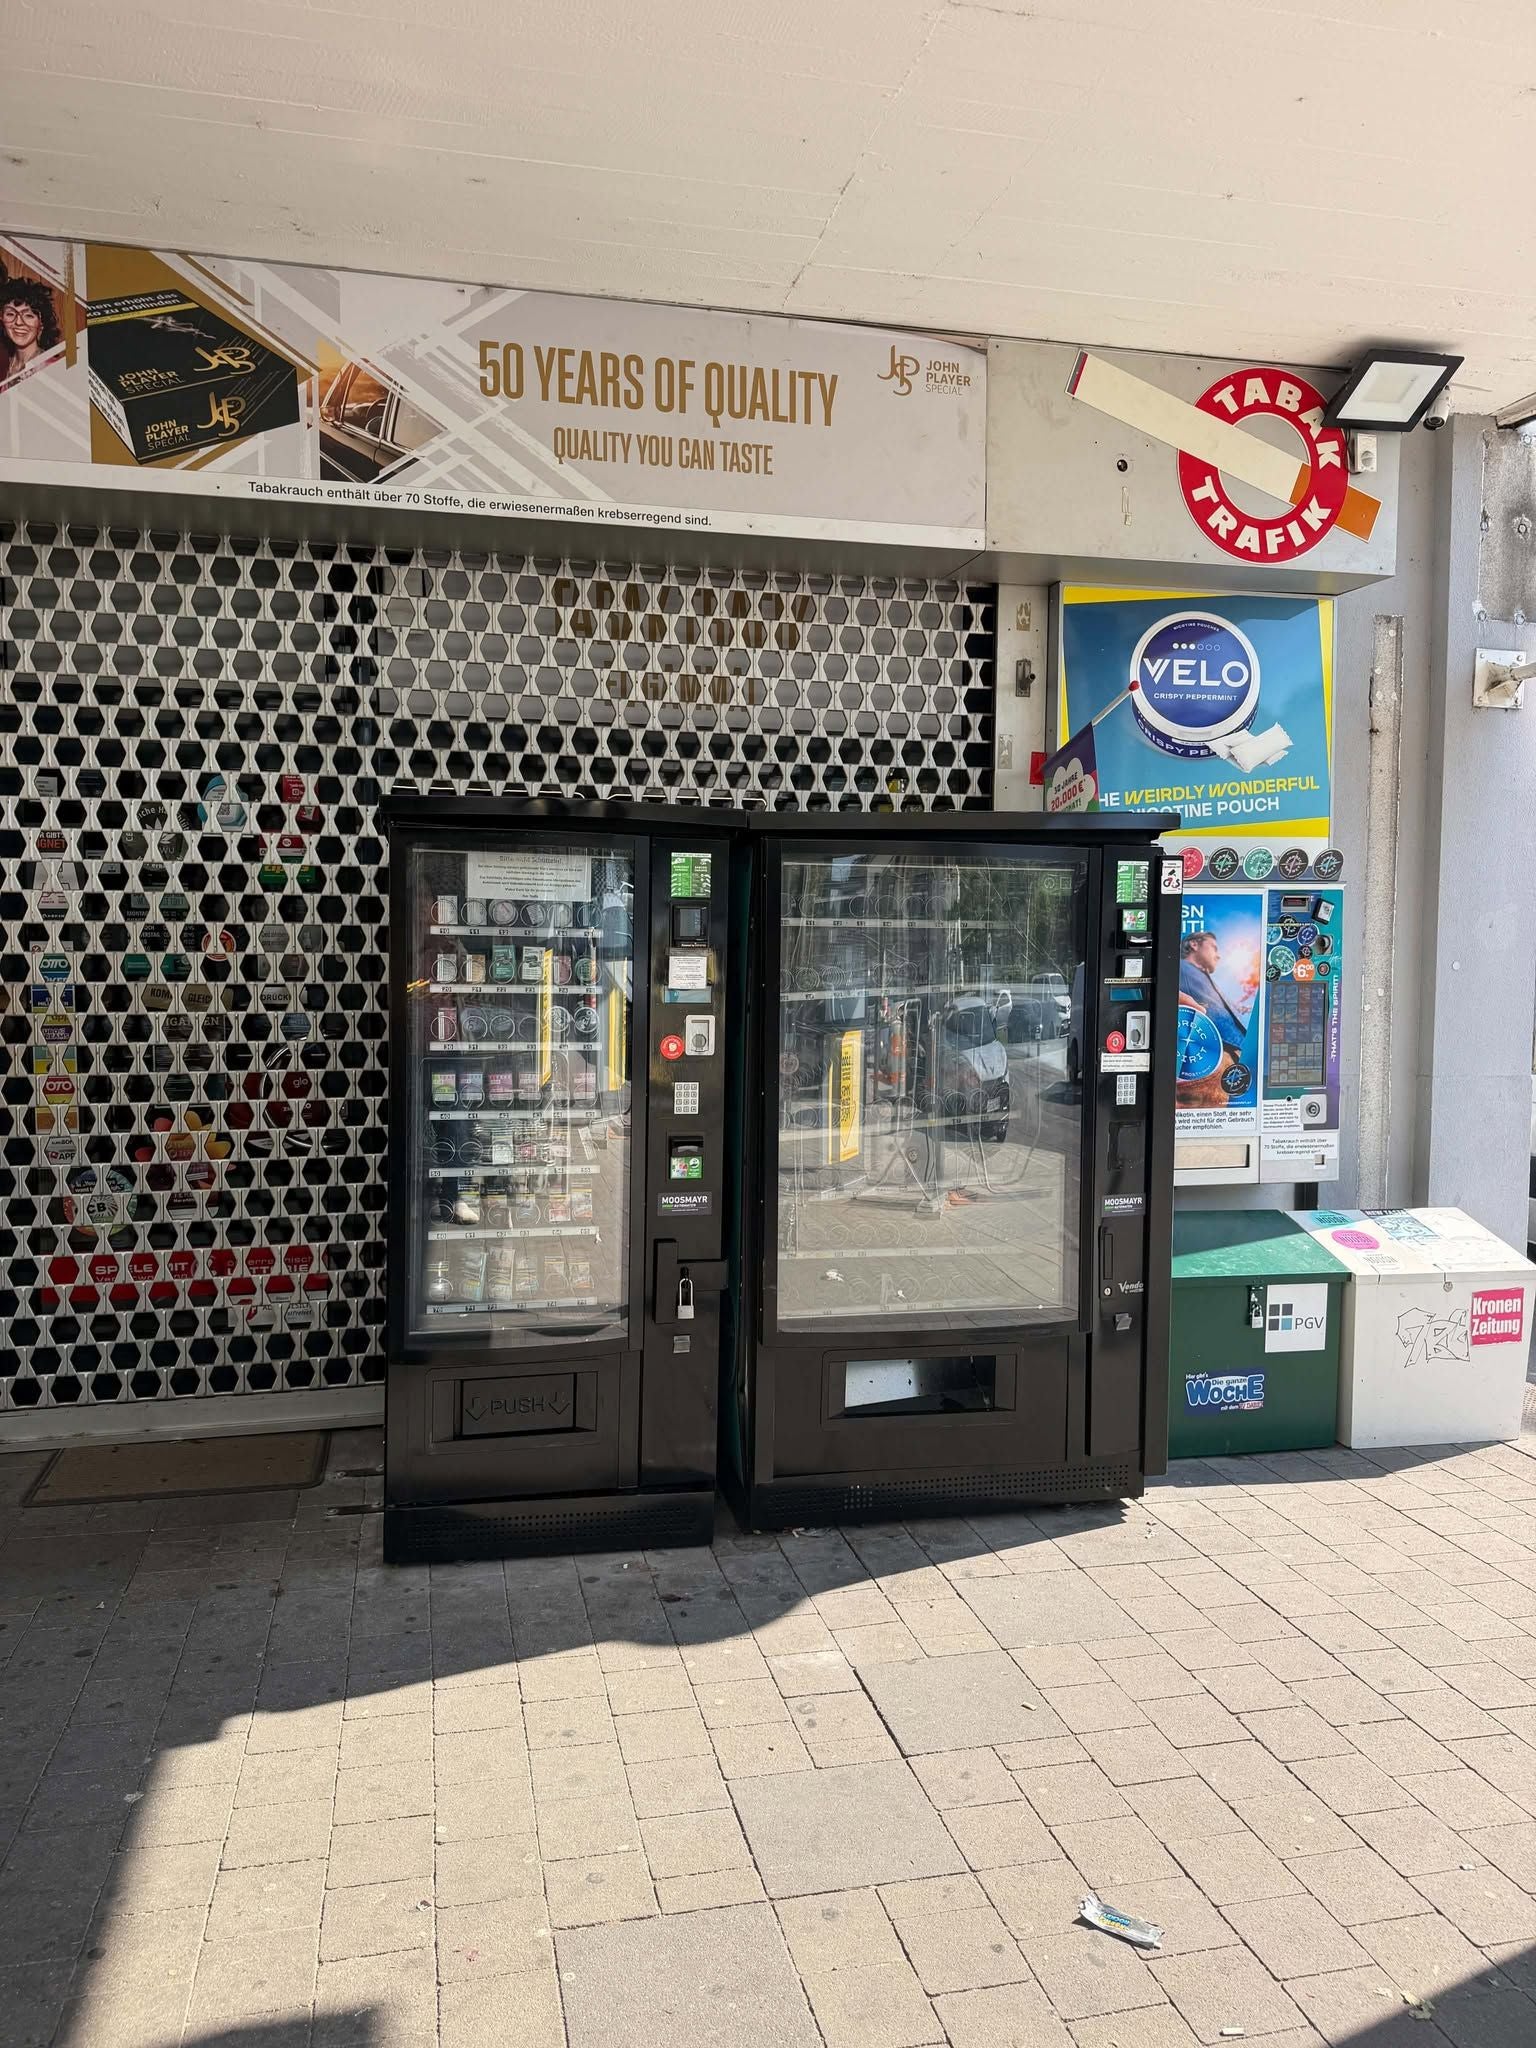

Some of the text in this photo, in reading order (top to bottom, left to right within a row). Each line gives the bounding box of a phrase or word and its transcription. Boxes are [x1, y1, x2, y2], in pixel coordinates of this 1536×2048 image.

[105, 306, 120, 315] zu
[121, 298, 181, 314] erblinden
[114, 294, 153, 308] erhöht
[156, 292, 177, 302] das
[118, 368, 159, 382] JOHN
[926, 360, 960, 373] JOHN
[120, 371, 179, 389] PLAYER
[125, 378, 185, 395] SPECIAL
[478, 341, 839, 428] 50 YEARS OF QUALITY
[926, 373, 971, 387] PLAYER
[925, 384, 963, 396] SPECIAL
[144, 419, 178, 434] JOHN
[1212, 377, 1341, 469] TABAK
[145, 425, 189, 443] PLAYER
[147, 434, 191, 451] SPECIAL
[553, 427, 774, 475] QUALITY YOU CAN TASTE
[248, 481, 712, 526] Tabakrauch enthält über 70 Stoffe, die erwiesenermaßen krebserregend sind.
[1191, 475, 1332, 555] TRAFIK
[1142, 656, 1249, 688] VELO
[1154, 692, 1238, 701] CRISPY PEPPERMINT
[1138, 718, 1184, 756] CRISPY
[1099, 775, 1320, 807] HE WEIRDLY WONDERFUL
[1217, 796, 1280, 817] POUCH
[292, 1076, 309, 1089] glo
[661, 1195, 708, 1204] MOOSMAYR
[1104, 1197, 1143, 1206] MOOSMAYR
[1472, 1297, 1521, 1315] Kronen
[1294, 1316, 1324, 1330] PGV
[1471, 1316, 1521, 1336] Zeitung
[1185, 1374, 1265, 1406] WOCHE
[1225, 1377, 1247, 1386] ganze
[490, 1393, 545, 1416] PUSH
